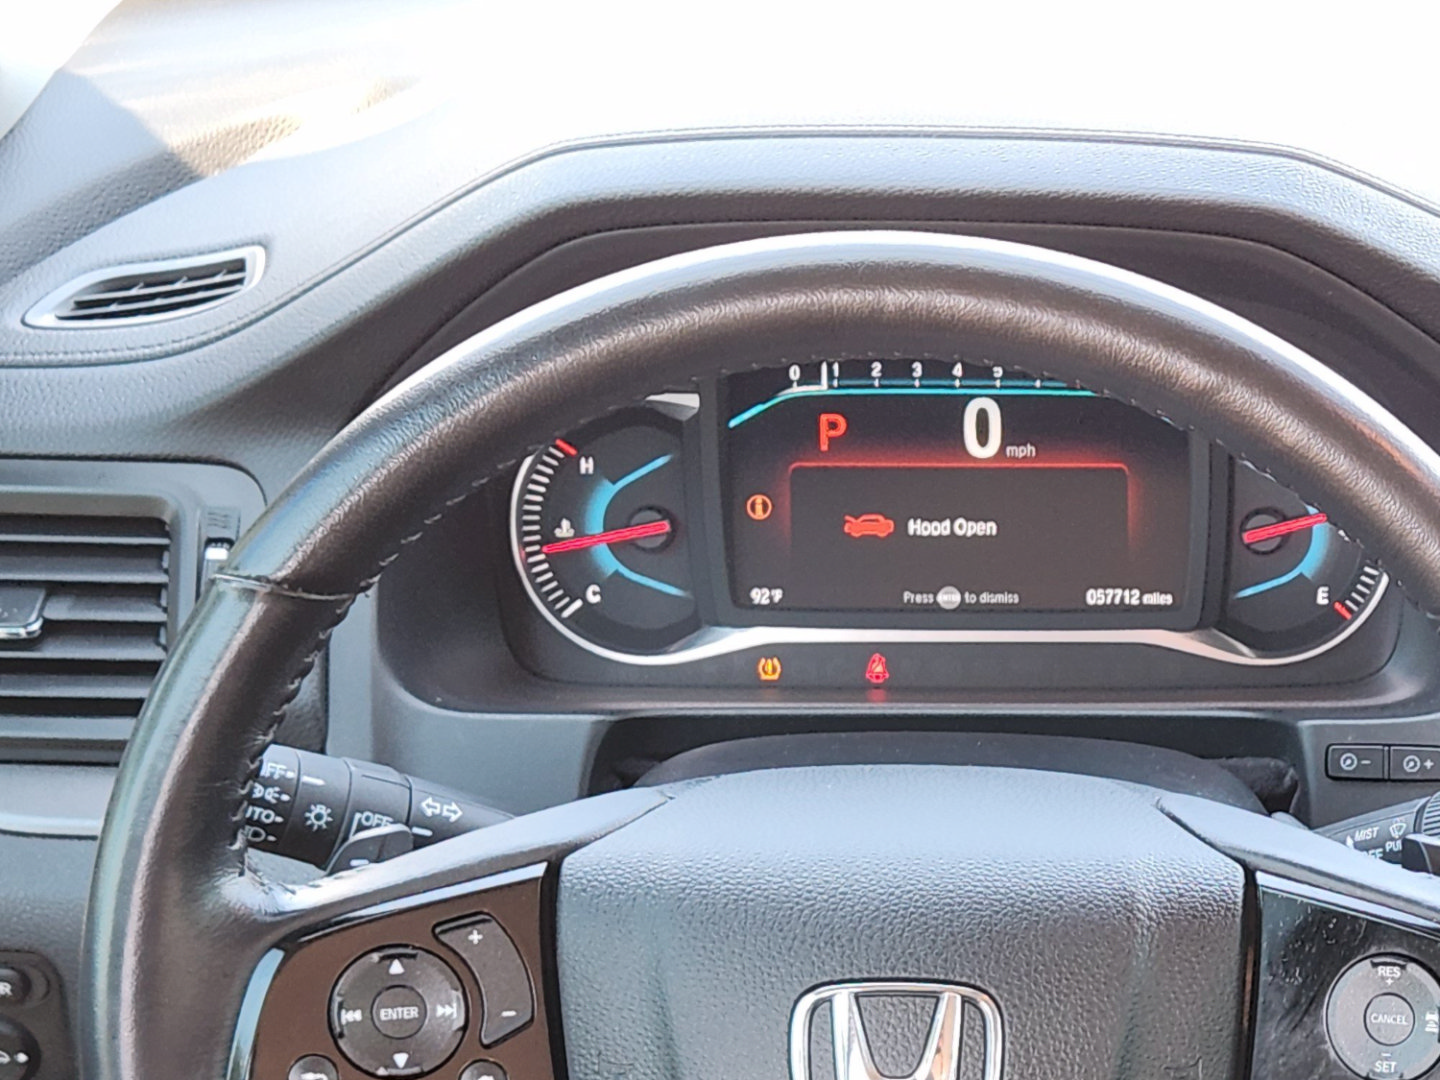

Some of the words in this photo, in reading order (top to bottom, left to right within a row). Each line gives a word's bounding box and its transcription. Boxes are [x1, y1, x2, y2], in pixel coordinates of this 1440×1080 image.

[871, 362, 883, 377] 2
[911, 362, 923, 377] 3
[952, 362, 963, 377] 4
[818, 413, 847, 452] P
[963, 397, 1002, 459] 0
[1006, 443, 1036, 459] mph
[579, 456, 594, 474] H
[907, 518, 950, 537] Hood
[954, 518, 997, 539] Open
[585, 584, 601, 604] C
[903, 590, 935, 604] Press
[964, 591, 977, 604] to
[979, 590, 1019, 604] dismiss
[1086, 588, 1140, 606] 057712
[1316, 586, 1329, 605] E
[1355, 826, 1379, 841] MIST
[1378, 966, 1401, 979] RES
[380, 1005, 420, 1021] ENTER
[1371, 1013, 1409, 1026] CANCEL
[1375, 1060, 1397, 1073] SET
